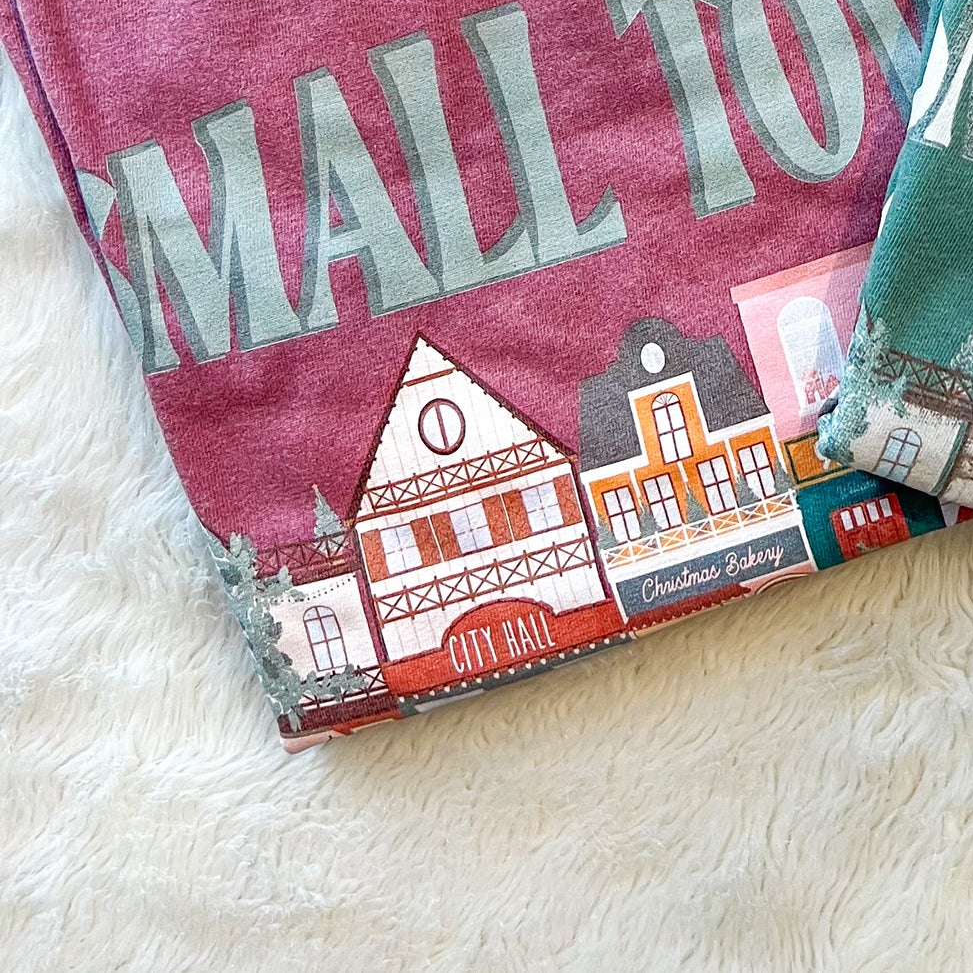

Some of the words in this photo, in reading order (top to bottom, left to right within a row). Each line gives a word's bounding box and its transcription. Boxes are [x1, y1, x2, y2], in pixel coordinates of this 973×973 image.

[642, 564, 721, 603] Christmas
[726, 543, 785, 577] Bakery
[448, 624, 498, 674] CITY
[500, 611, 556, 658] HALL
